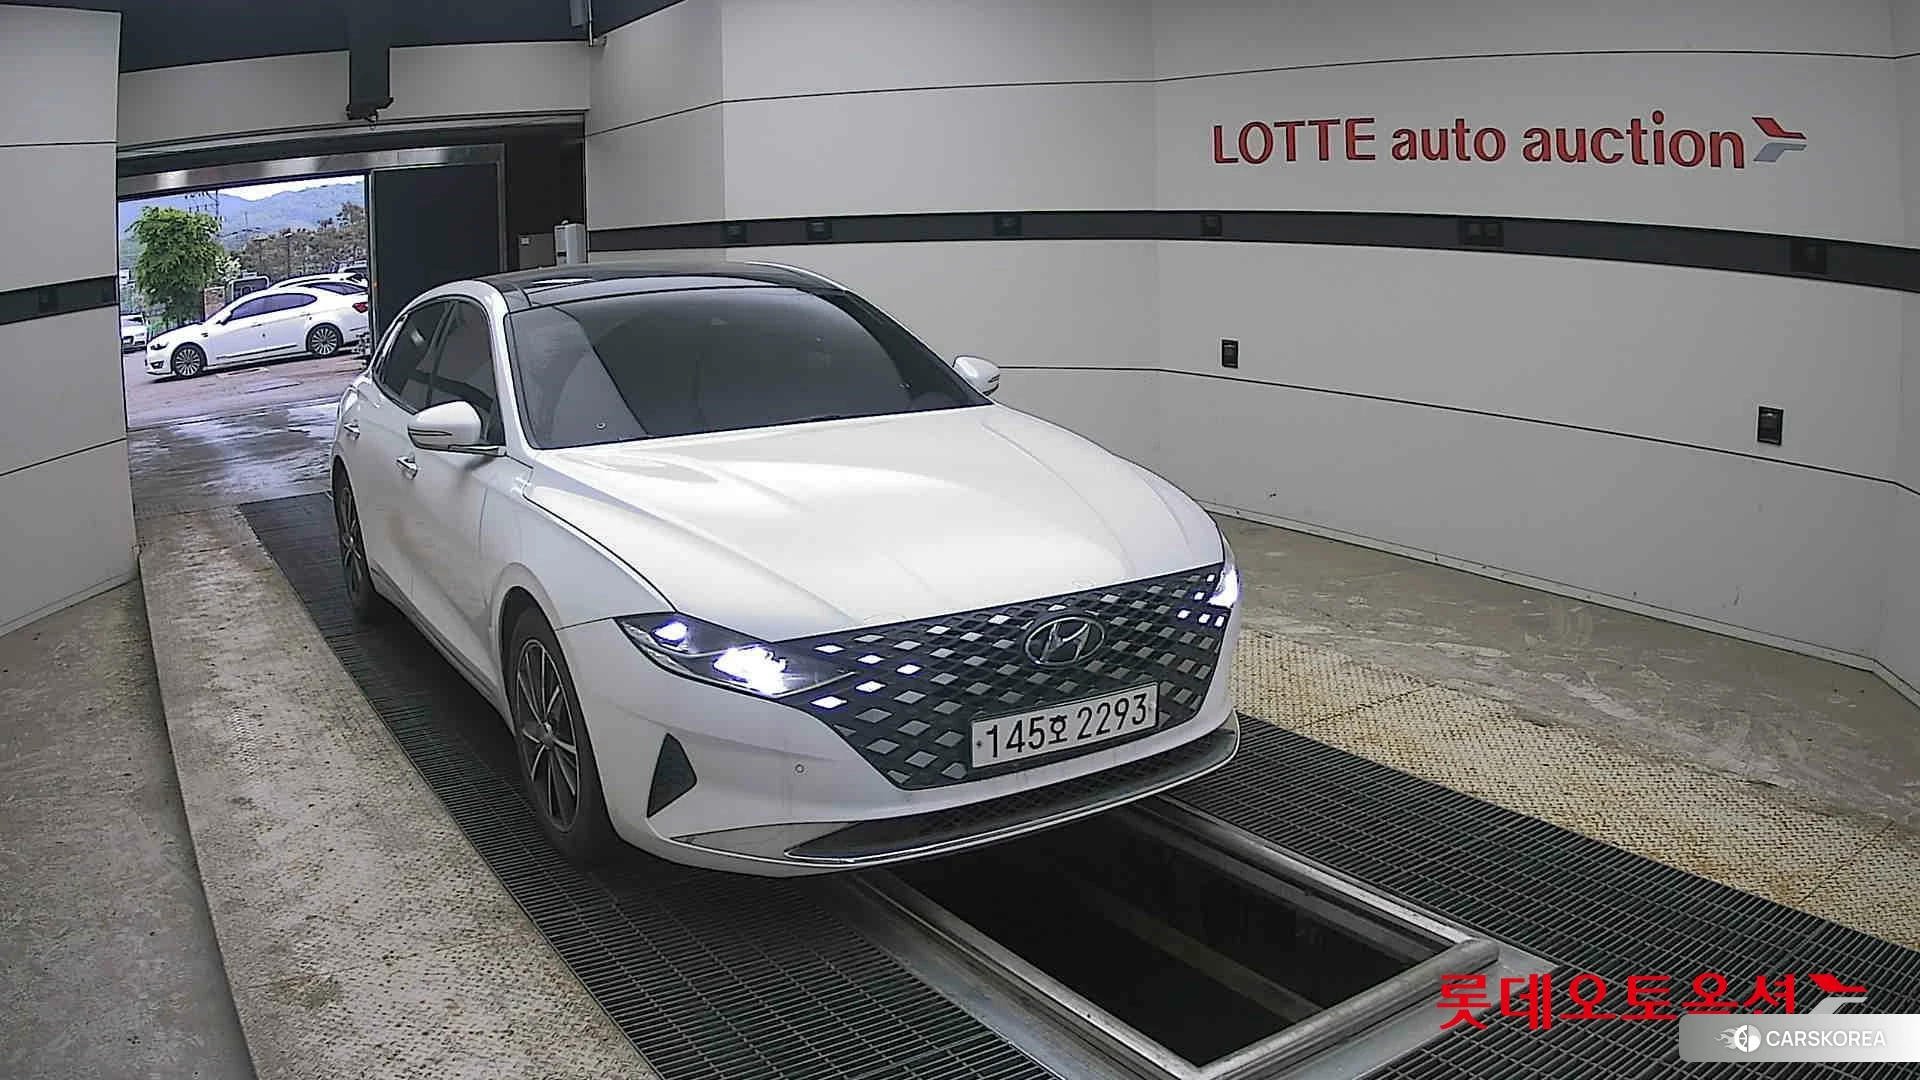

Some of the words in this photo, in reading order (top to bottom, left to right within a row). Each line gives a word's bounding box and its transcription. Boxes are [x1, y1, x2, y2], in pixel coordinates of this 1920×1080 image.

[1213, 117, 1376, 164] LOTTE
[1391, 118, 1506, 162] auto
[1522, 110, 1745, 169] auction
[986, 714, 1068, 759] 145호
[1077, 693, 1148, 741] 2293
